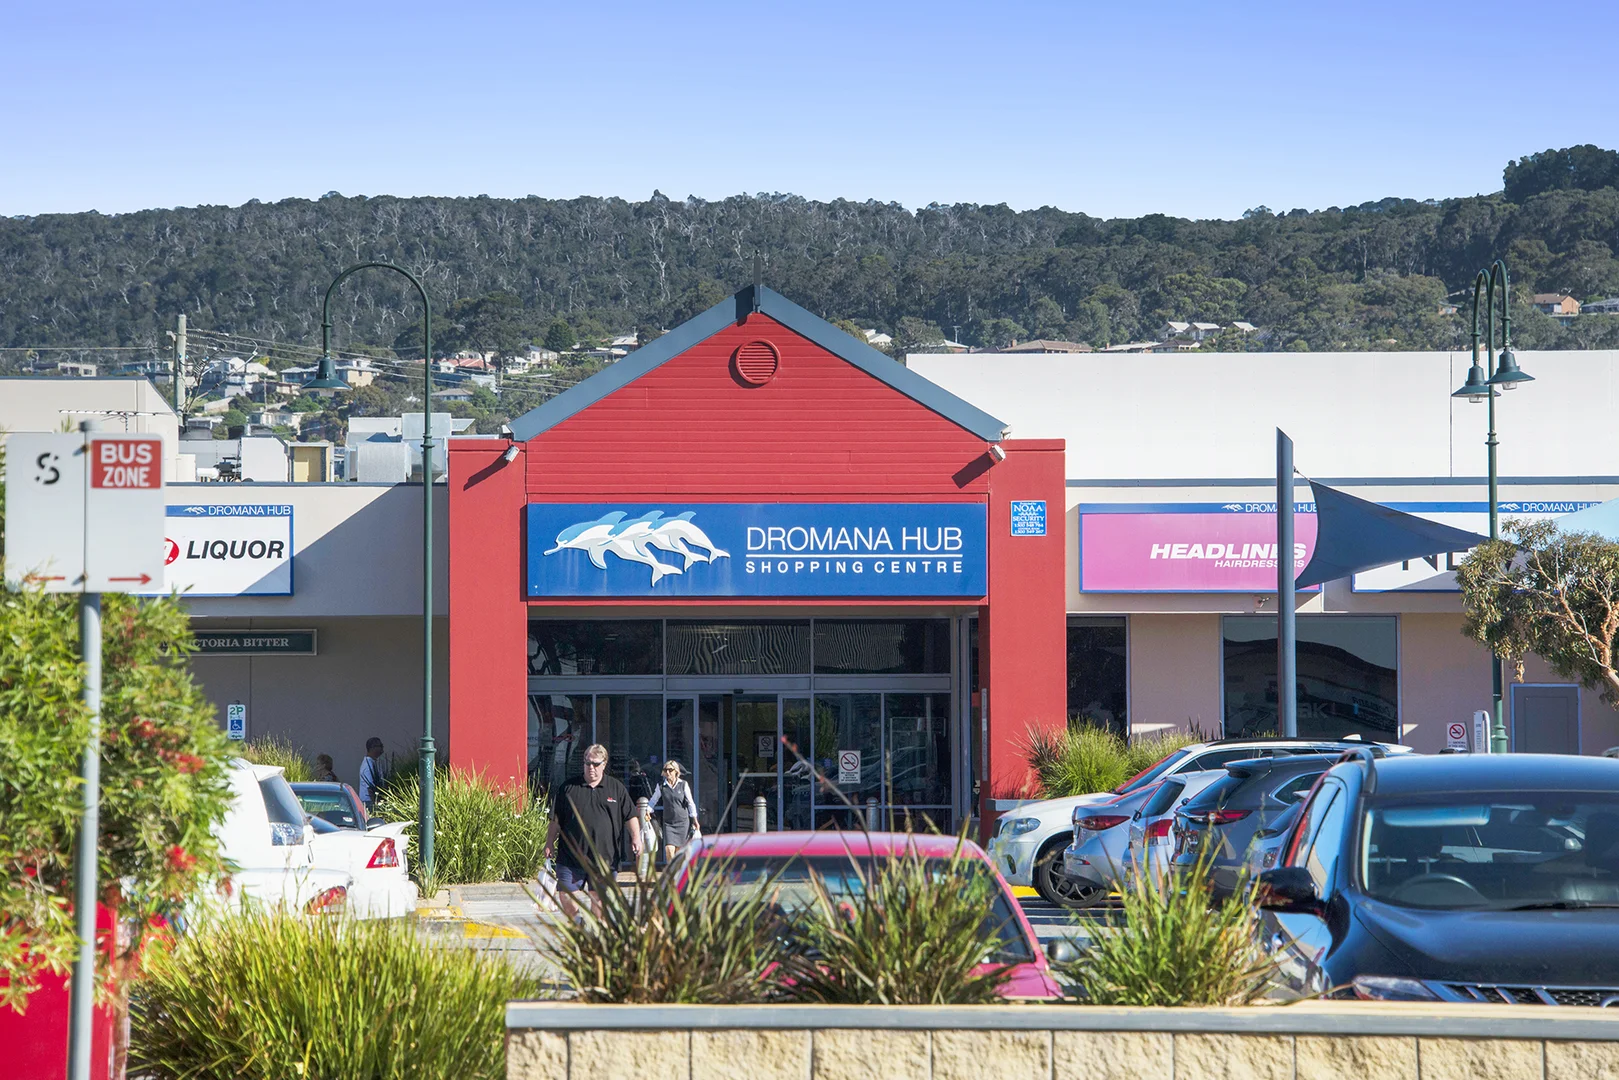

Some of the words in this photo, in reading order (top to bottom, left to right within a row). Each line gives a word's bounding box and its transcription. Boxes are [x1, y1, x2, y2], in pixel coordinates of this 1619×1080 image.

[100, 443, 153, 464] BUS
[103, 466, 151, 487] ZONE
[208, 505, 264, 515] DROMANA
[267, 505, 291, 515] HUB
[1013, 504, 1043, 512] NOAA
[1522, 502, 1575, 512] DROMANA
[746, 526, 894, 551] DROMANA
[902, 526, 963, 551] HUB
[186, 540, 285, 561] LIQUOR
[745, 561, 864, 574] SHOPPING
[873, 561, 963, 574] CENTRE
[243, 637, 289, 647] BITTER
[229, 707, 244, 715] 2P
